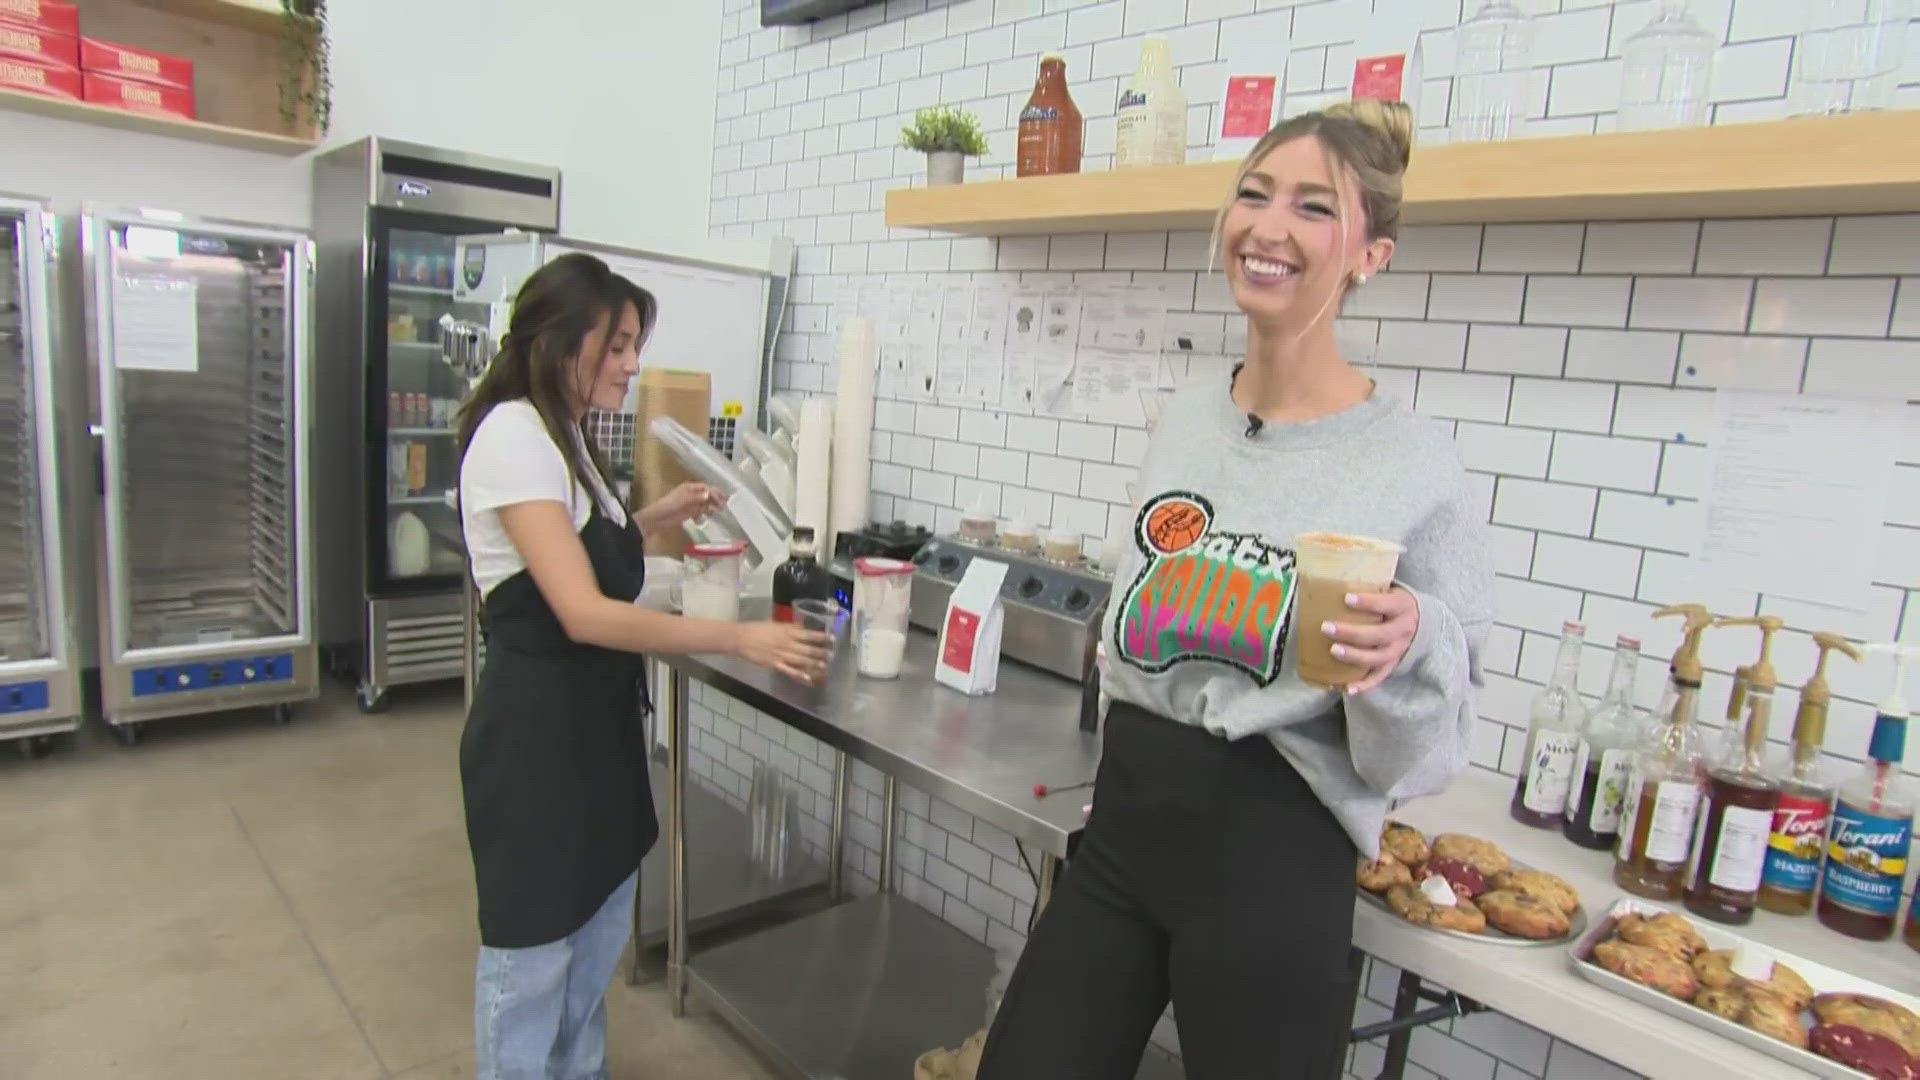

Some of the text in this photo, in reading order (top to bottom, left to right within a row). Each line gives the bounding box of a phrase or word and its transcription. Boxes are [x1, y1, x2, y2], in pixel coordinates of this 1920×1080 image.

[1126, 555, 1284, 666] SPURS
[1833, 816, 1906, 847] Torani
[1828, 866, 1894, 897] RASPBERRY
